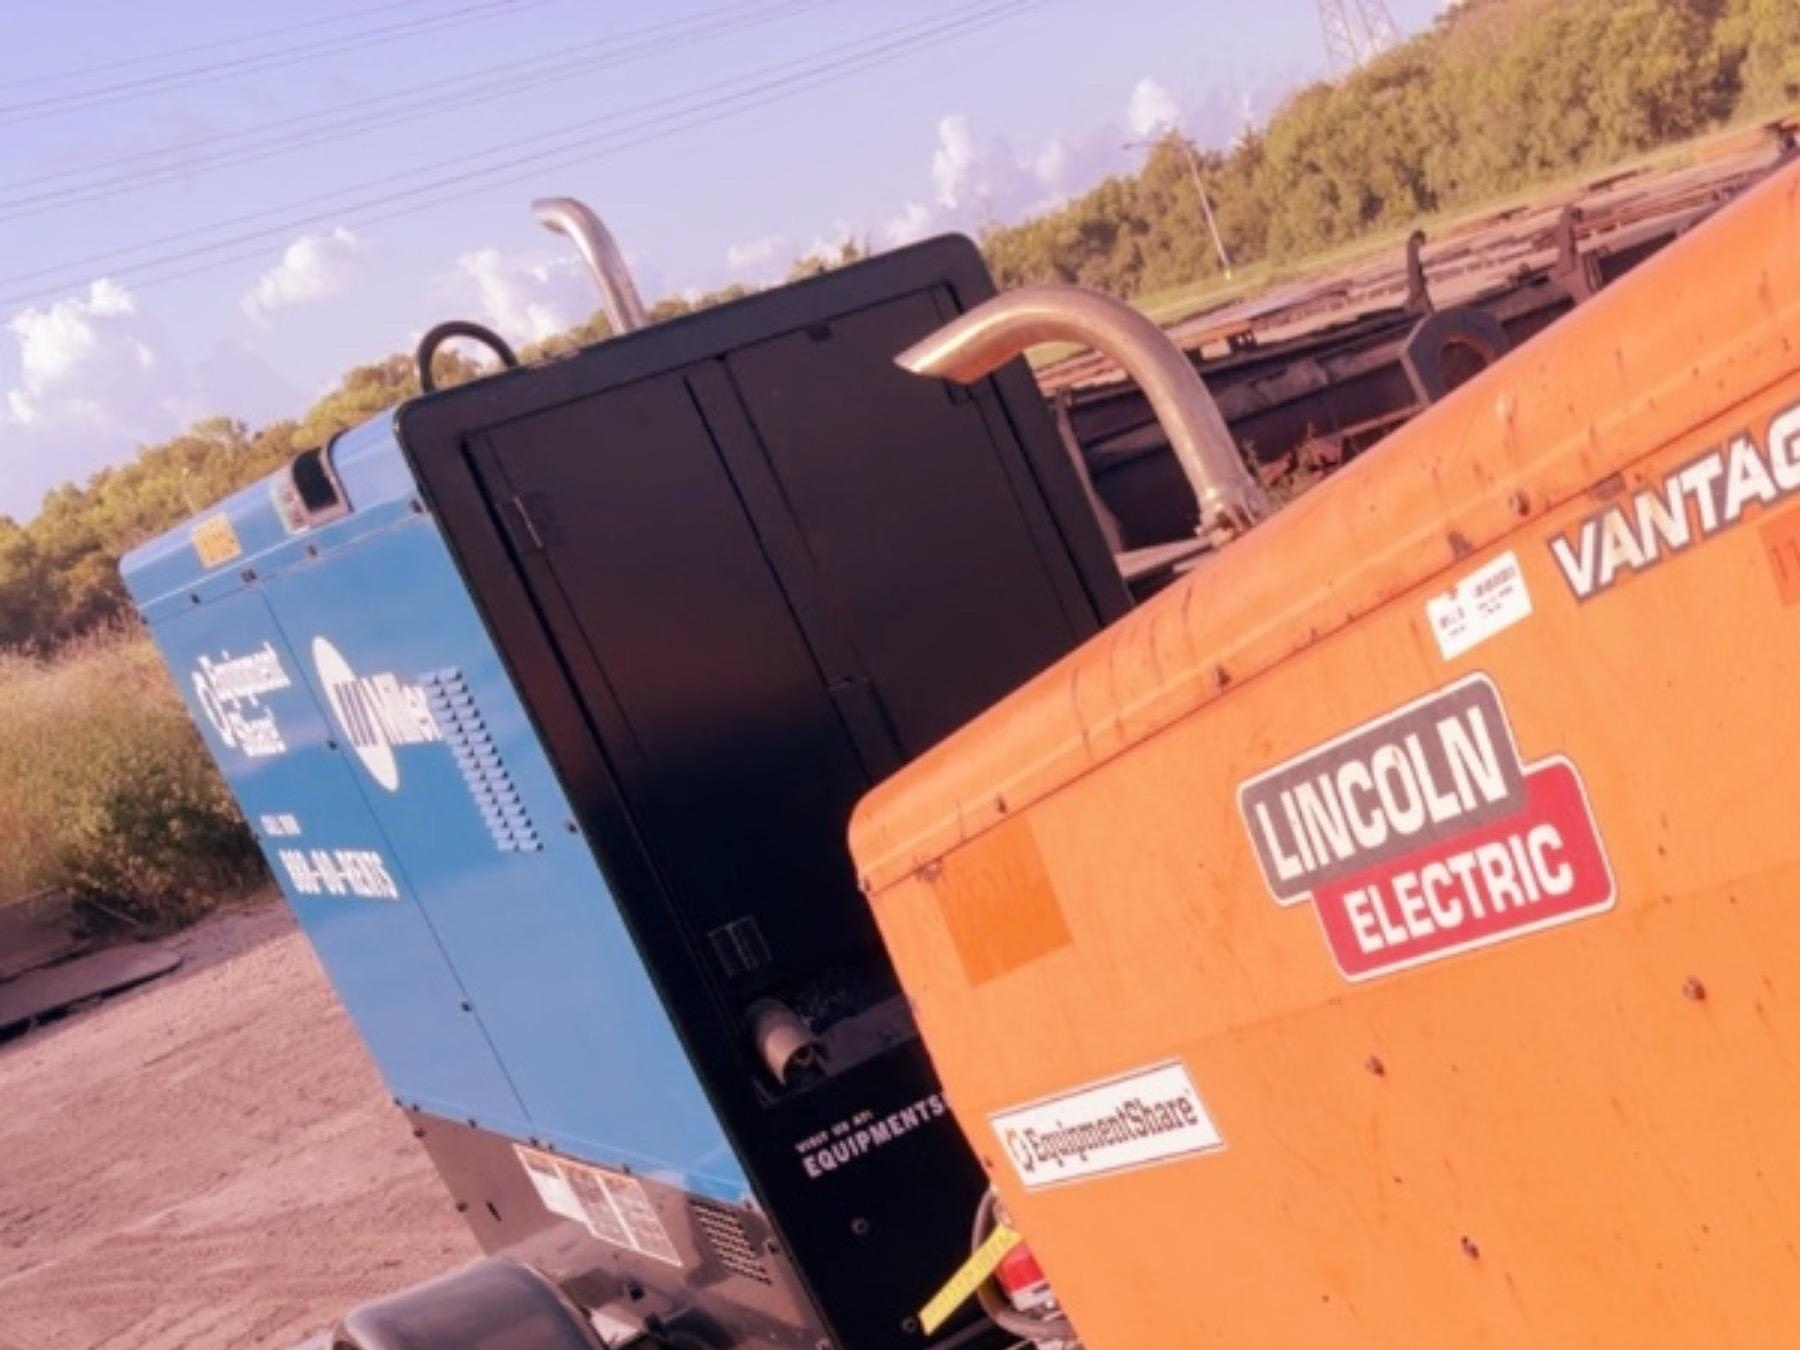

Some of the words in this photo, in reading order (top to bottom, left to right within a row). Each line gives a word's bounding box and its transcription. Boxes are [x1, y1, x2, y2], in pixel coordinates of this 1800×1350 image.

[1254, 704, 1508, 881] LINCOLN
[1342, 822, 1575, 954] ELECTRIC
[1021, 1094, 1200, 1168] EquipmentShare
